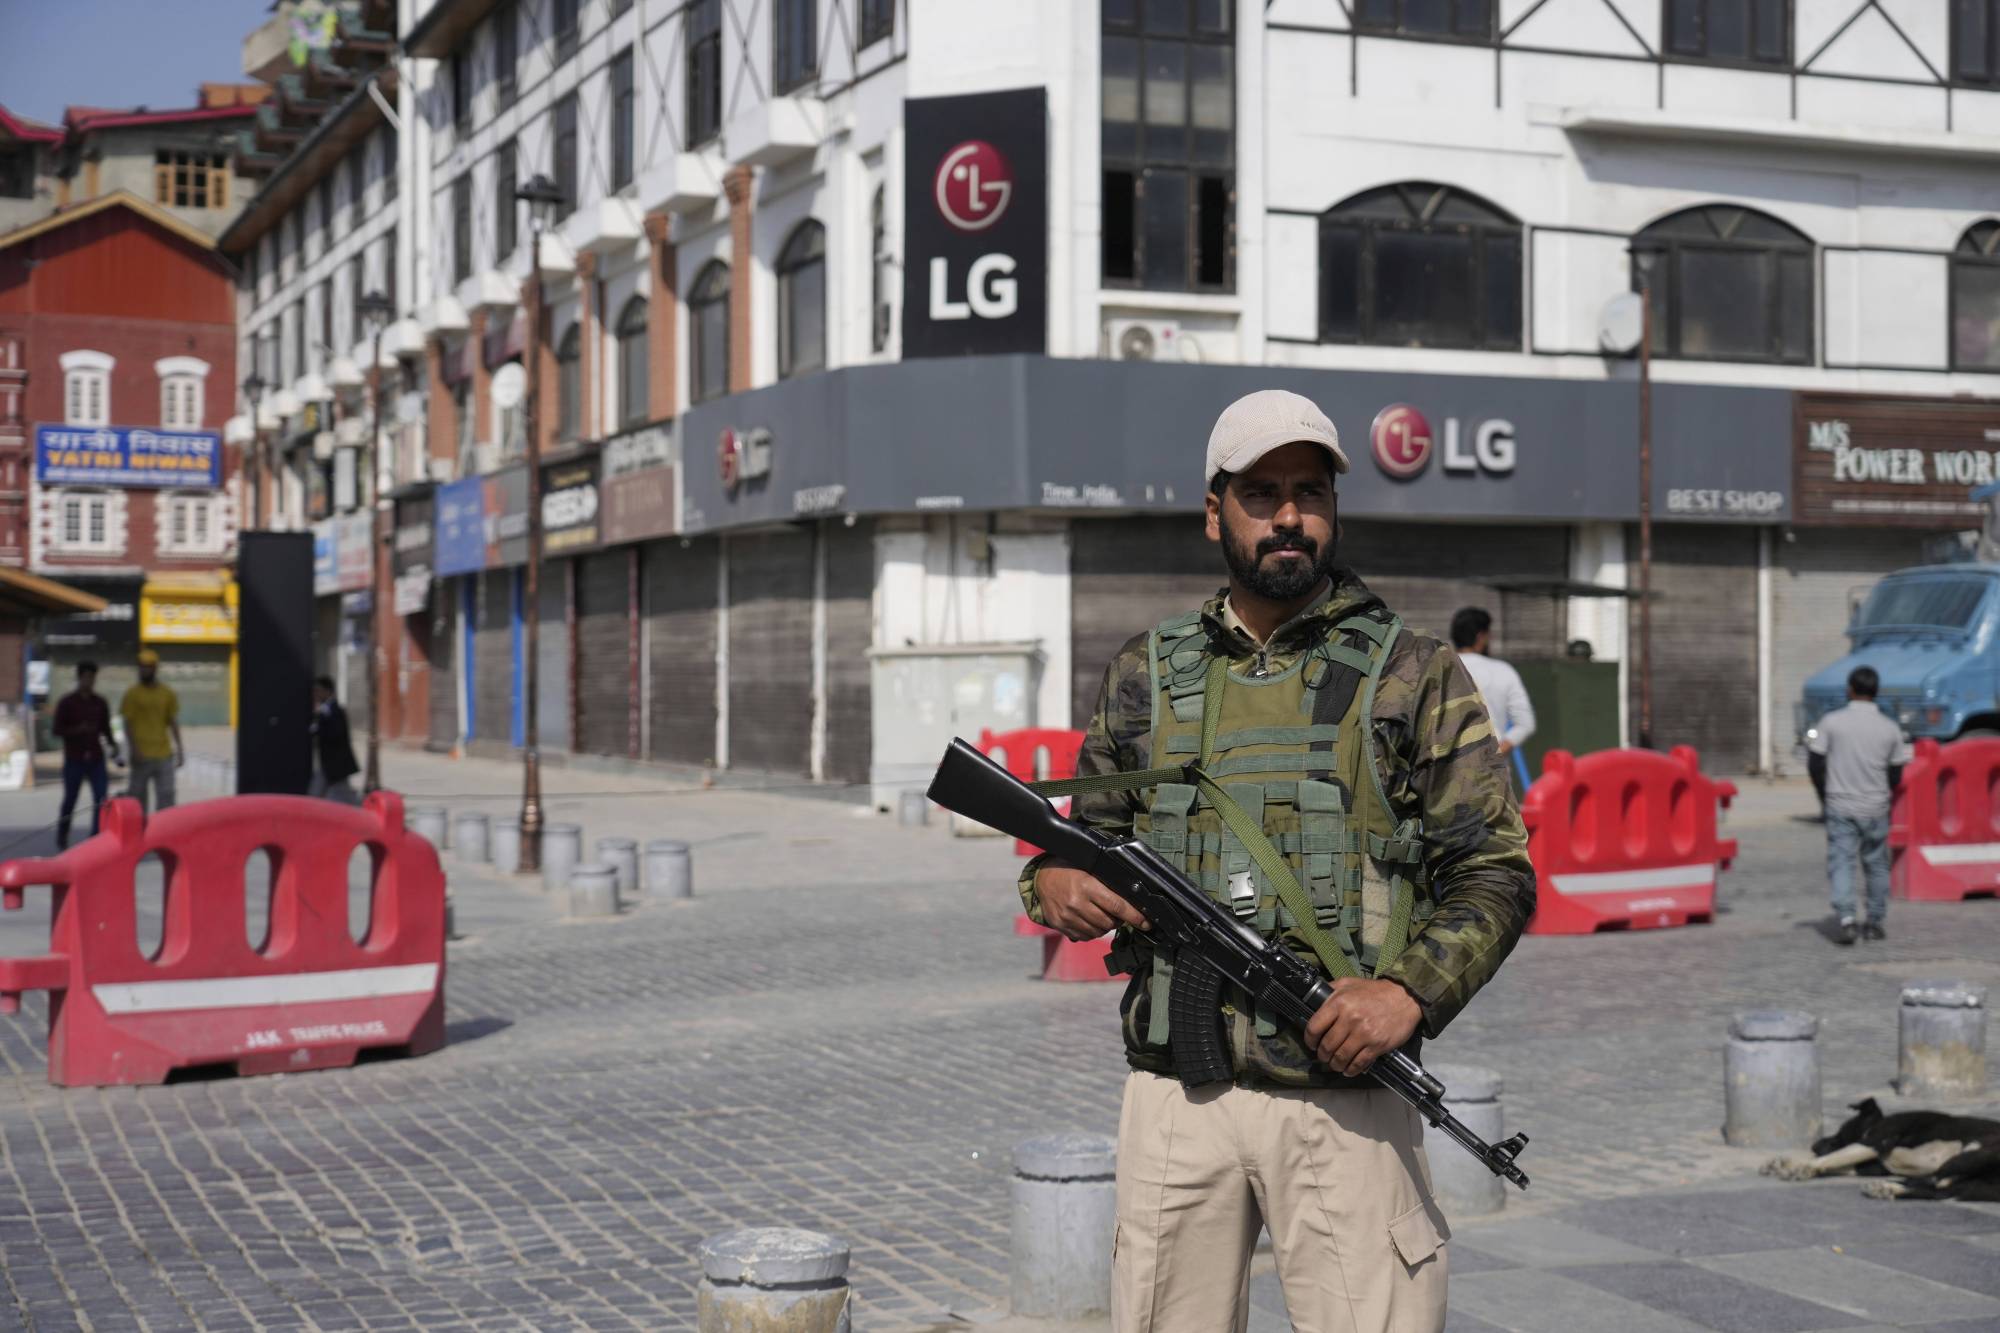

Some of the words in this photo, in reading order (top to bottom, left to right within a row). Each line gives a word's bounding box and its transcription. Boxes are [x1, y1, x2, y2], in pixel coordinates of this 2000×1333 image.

[929, 253, 1018, 320] LG
[1442, 416, 1516, 472] LG
[1834, 446, 1926, 484] POWER
[1667, 488, 1720, 511] BEST
[1724, 489, 1784, 513] SHOP
[246, 1029, 282, 1049] J&K
